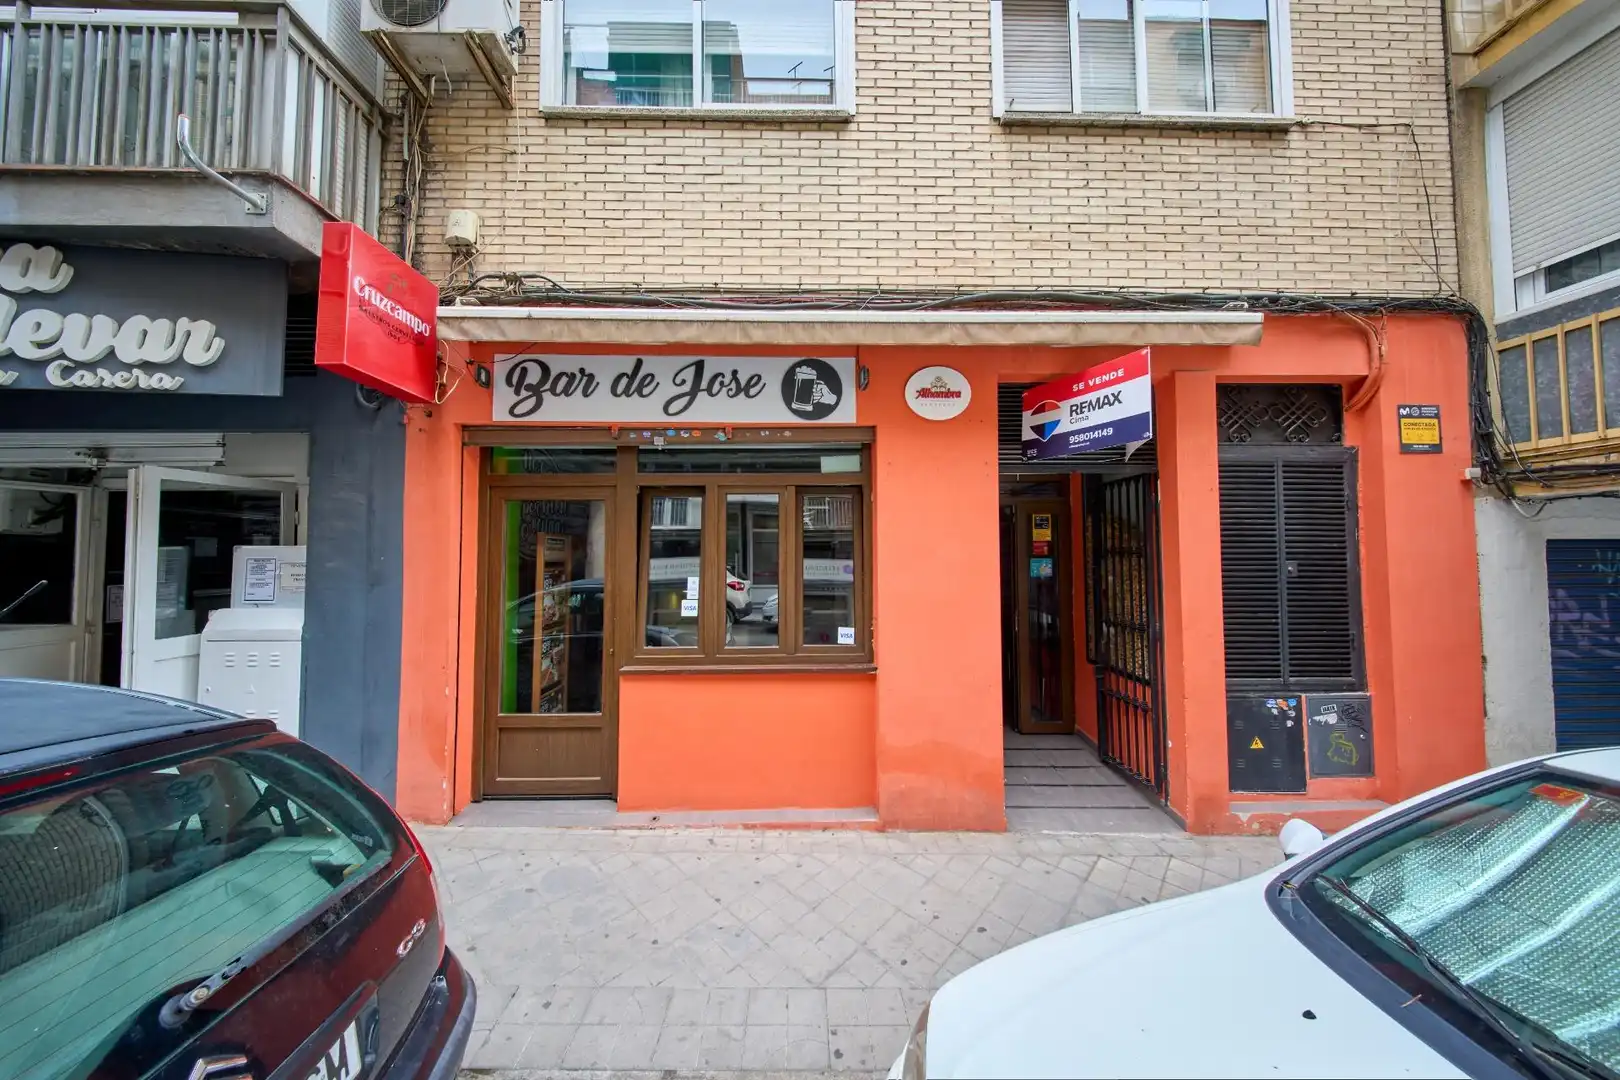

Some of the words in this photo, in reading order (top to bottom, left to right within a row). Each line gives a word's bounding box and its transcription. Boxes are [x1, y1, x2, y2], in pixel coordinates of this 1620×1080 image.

[353, 275, 431, 337] Cruzcampo
[46, 360, 184, 390] Casera
[1072, 382, 1085, 392] SE
[1088, 368, 1124, 387] VENDE
[505, 358, 599, 418] Bar
[610, 358, 659, 398] de
[663, 359, 766, 416] Jose
[915, 388, 961, 400] Alhambra
[1069, 390, 1122, 417] REMAX
[1069, 414, 1089, 425] Cima
[1069, 427, 1113, 444] 958014149
